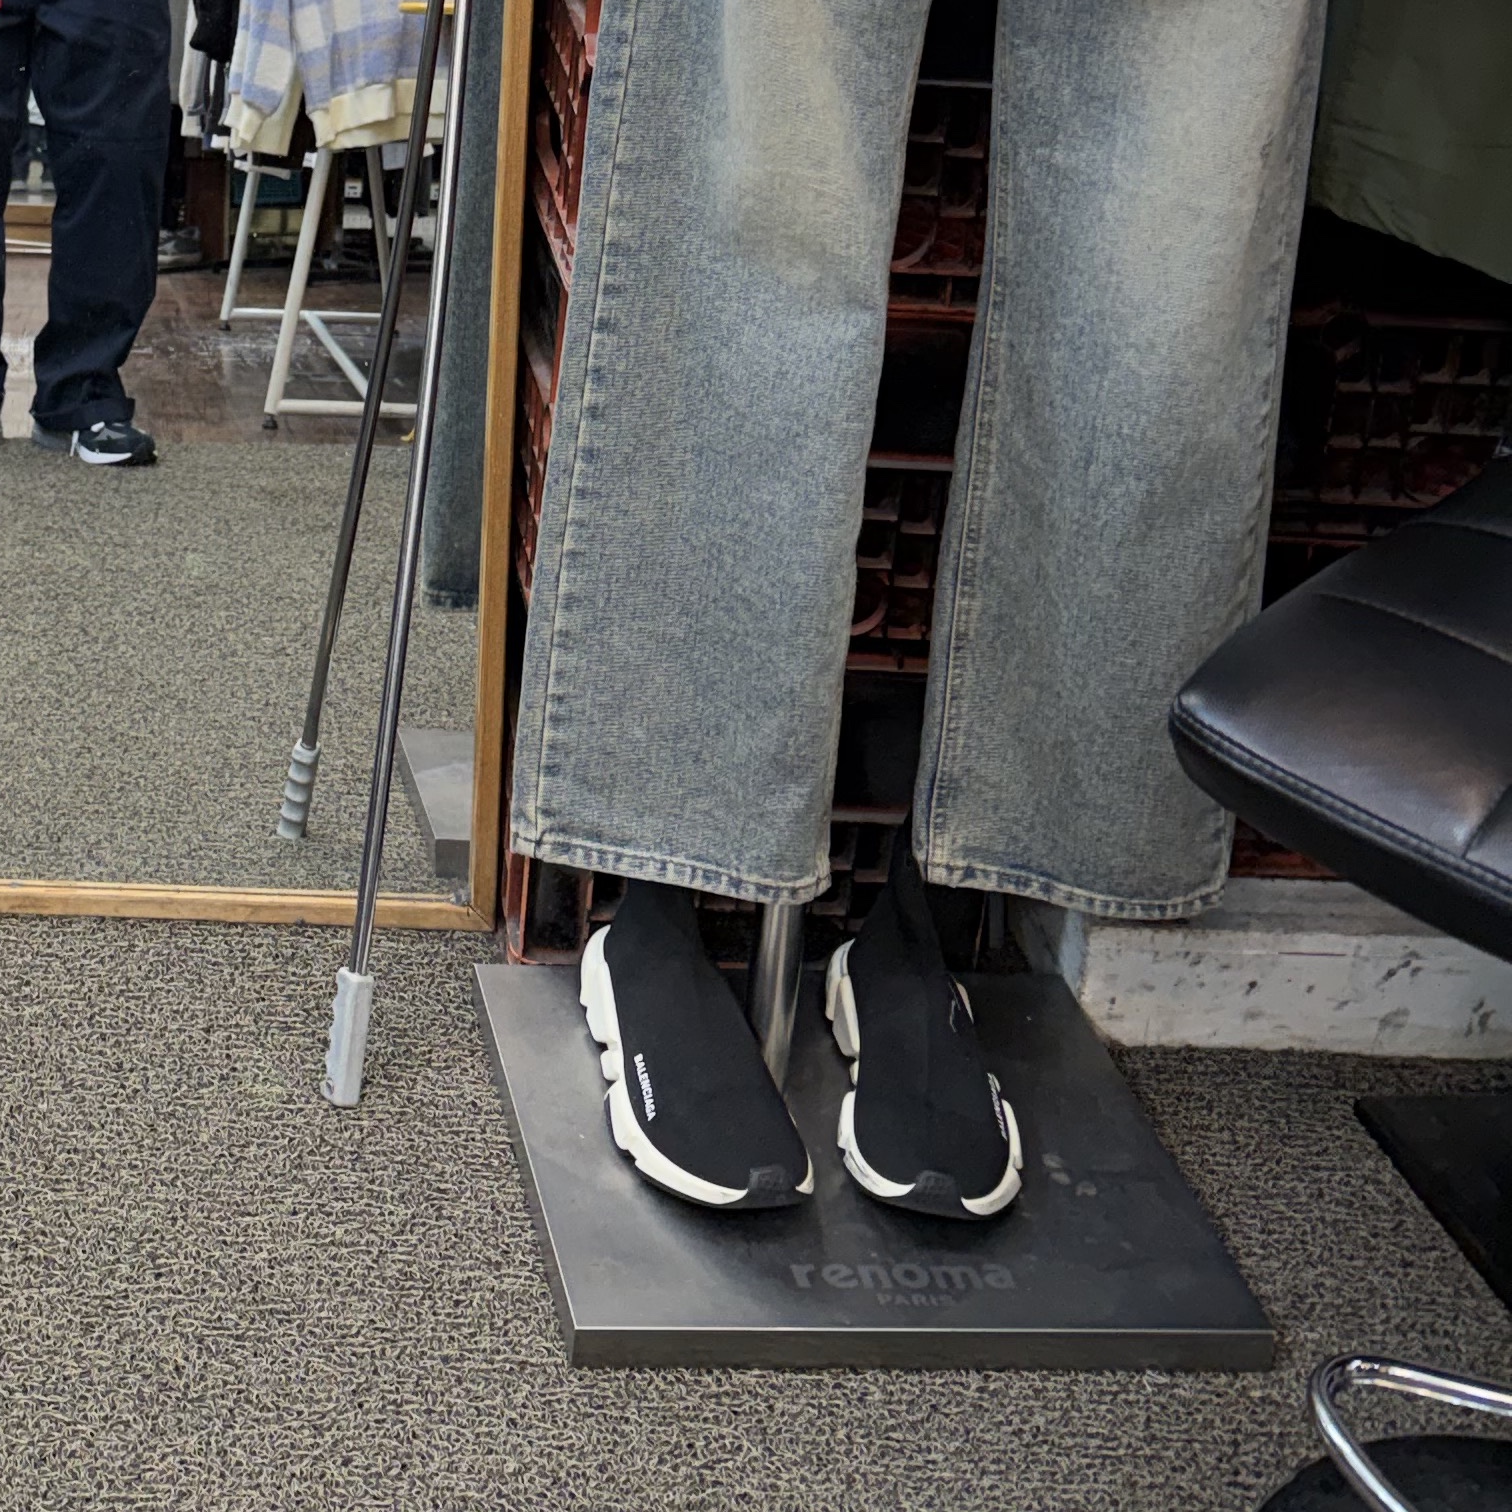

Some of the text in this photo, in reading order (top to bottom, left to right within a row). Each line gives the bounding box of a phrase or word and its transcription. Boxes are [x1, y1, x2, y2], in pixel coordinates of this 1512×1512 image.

[633, 1053, 657, 1122] BALENCIAGA
[789, 1262, 1016, 1289] renoma
[876, 1292, 956, 1307] PARIS
